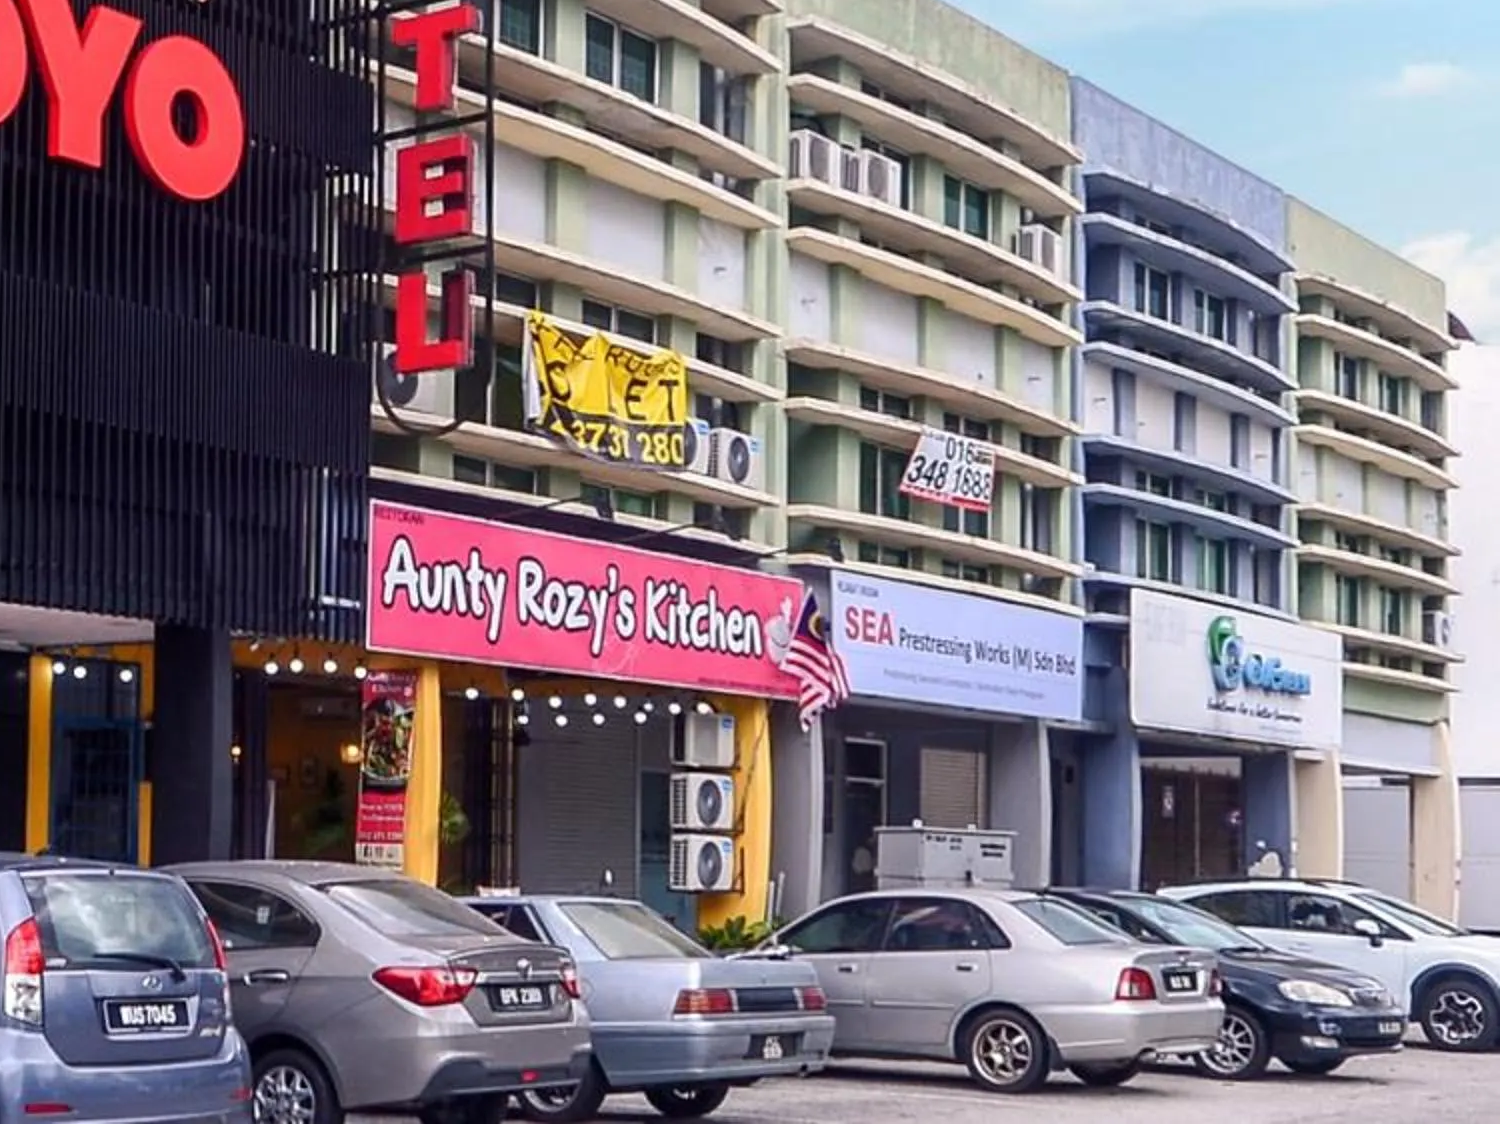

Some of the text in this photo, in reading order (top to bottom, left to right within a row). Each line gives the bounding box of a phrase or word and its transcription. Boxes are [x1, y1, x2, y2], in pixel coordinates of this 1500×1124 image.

[907, 455, 949, 489] 348
[381, 534, 764, 659] Aunty Rozy's Kitchen
[845, 606, 1077, 676] SEA Prestressing Works (M) Sdn Bhd
